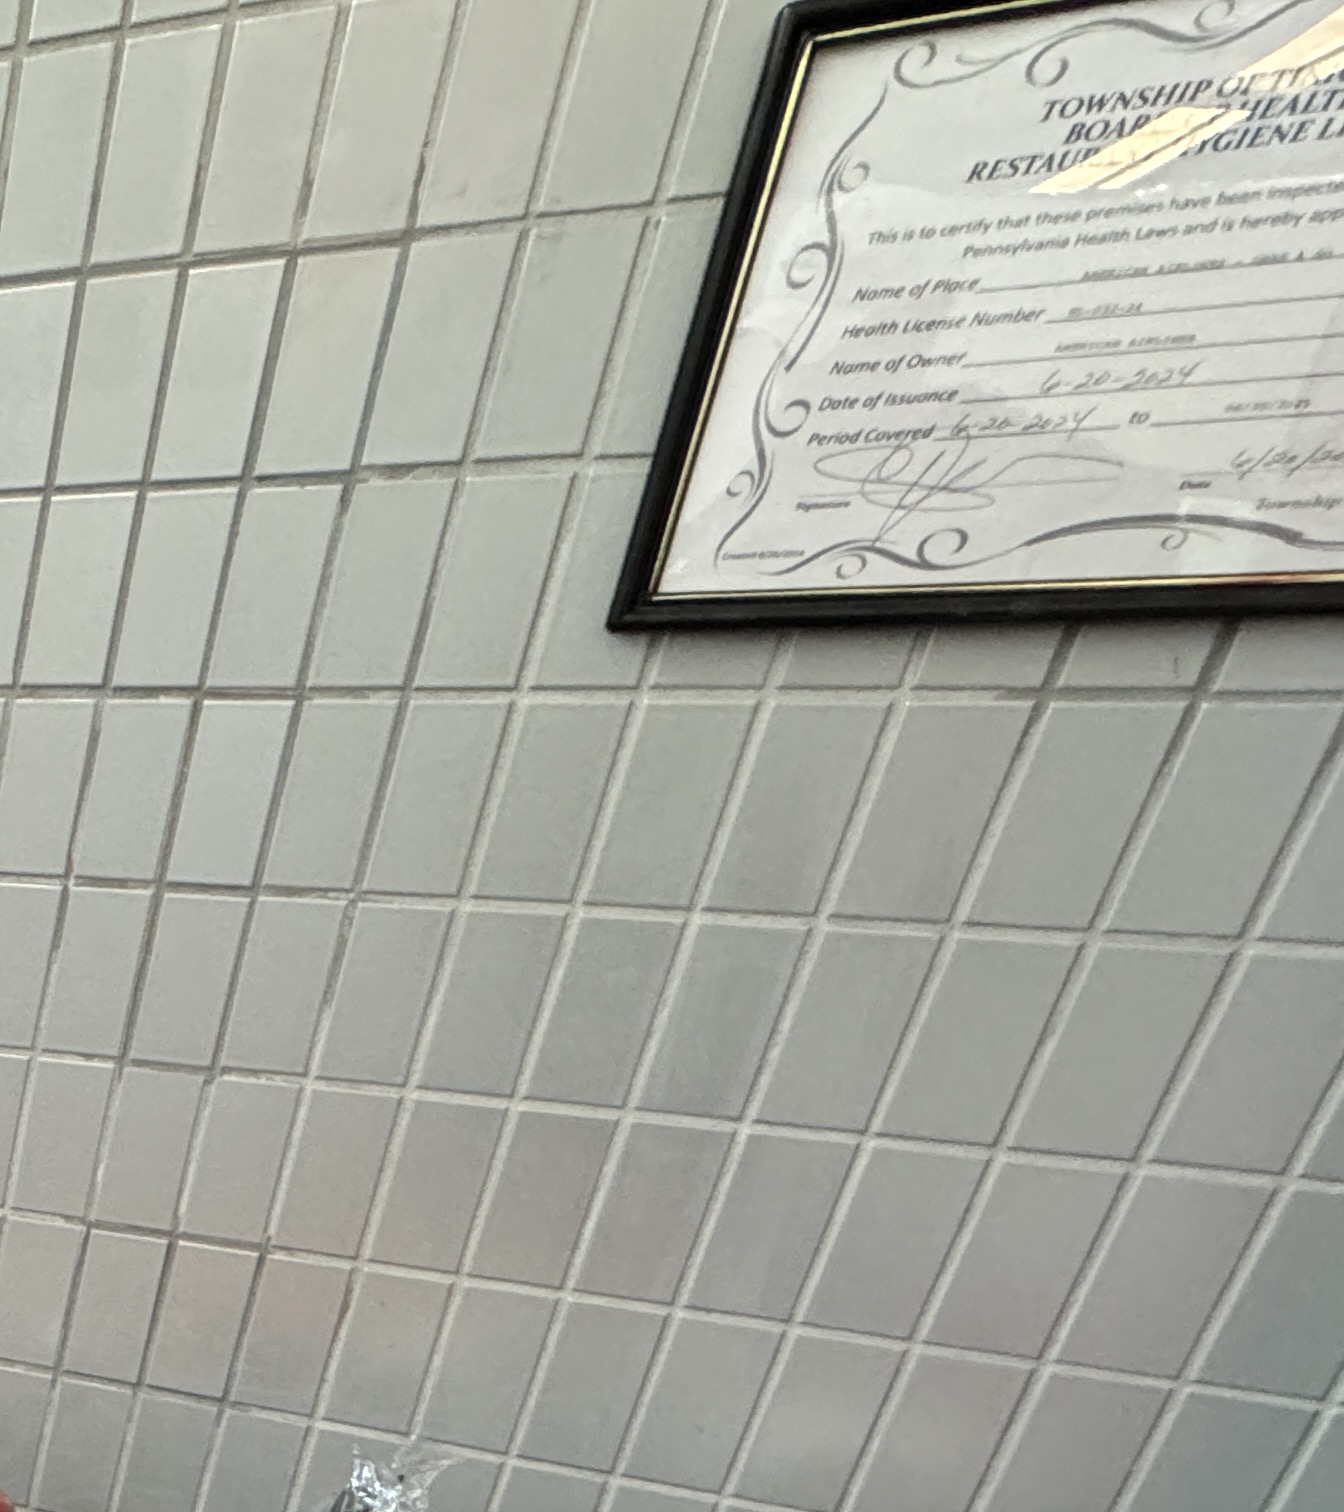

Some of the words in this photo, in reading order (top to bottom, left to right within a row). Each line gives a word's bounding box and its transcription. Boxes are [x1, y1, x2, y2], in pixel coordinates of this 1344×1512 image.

[1039, 79, 1214, 123] TOWNSHIP
[868, 230, 898, 246] This
[902, 228, 914, 242] is
[920, 225, 937, 240] to
[940, 217, 994, 238] certify
[997, 214, 1032, 230] that
[1035, 209, 1082, 226] these
[1085, 201, 1165, 223] premises
[962, 236, 1070, 259] Pennsylvania
[1073, 227, 1131, 248] Health
[1135, 226, 1179, 241] Laws
[1182, 217, 1220, 236] and
[1221, 216, 1234, 232] is
[1239, 211, 1308, 230] hereby
[852, 286, 906, 304] Name
[908, 278, 932, 300] of
[929, 276, 982, 295] Place
[841, 320, 899, 340] Health
[902, 314, 967, 335] License
[968, 306, 1047, 329] Number
[829, 360, 881, 376] Name
[884, 352, 907, 375] of
[906, 351, 968, 371] Owner
[818, 394, 859, 412] Date
[862, 390, 886, 411] of
[882, 387, 960, 407] Issuance
[1128, 408, 1152, 426] to
[806, 425, 861, 448] Period
[864, 421, 938, 443] Covered
